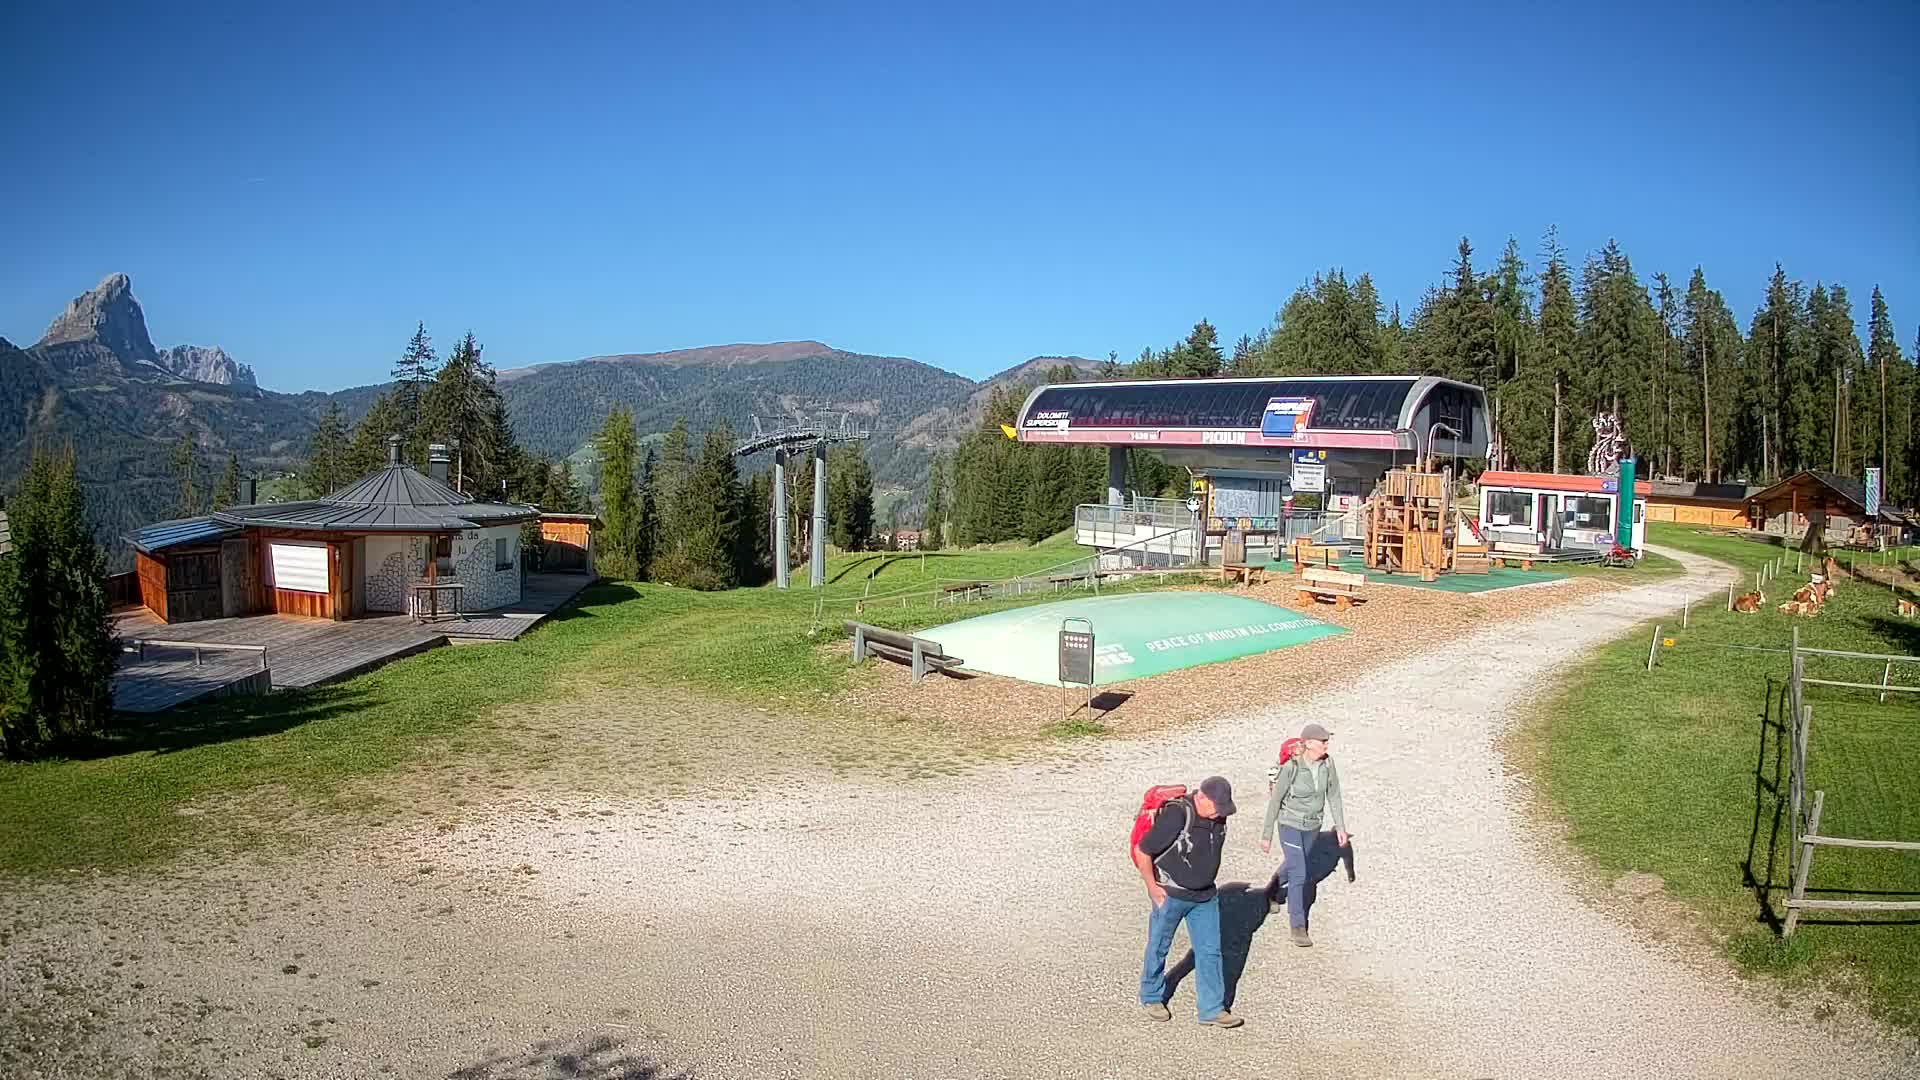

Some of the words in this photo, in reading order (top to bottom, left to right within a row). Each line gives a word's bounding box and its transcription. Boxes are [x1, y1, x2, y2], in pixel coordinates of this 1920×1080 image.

[1036, 411, 1069, 419] DOLOMITI
[1202, 432, 1246, 444] PICULIN
[1144, 637, 1189, 652] PEACE
[1187, 633, 1204, 645] OF
[1205, 629, 1237, 641] MIND
[1233, 627, 1250, 637] IN
[1247, 625, 1270, 635] ALL
